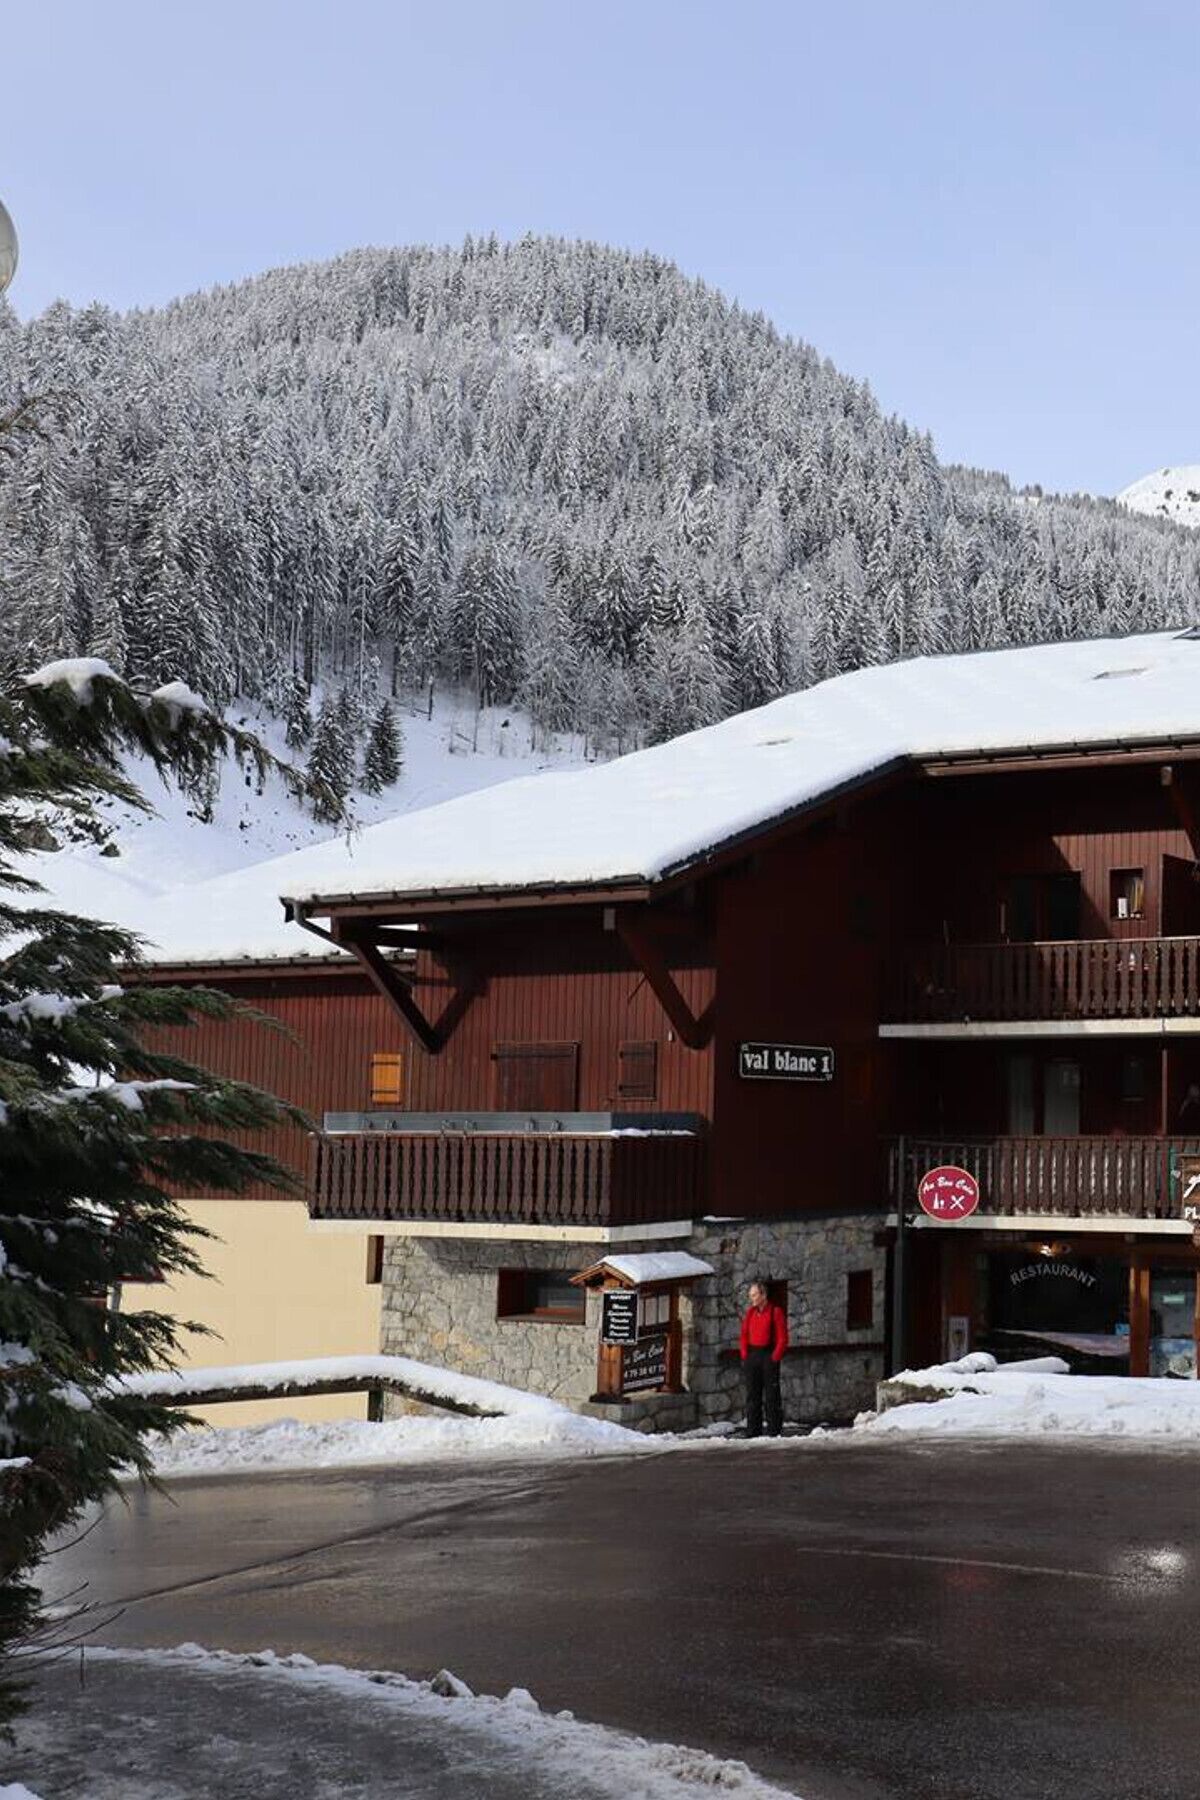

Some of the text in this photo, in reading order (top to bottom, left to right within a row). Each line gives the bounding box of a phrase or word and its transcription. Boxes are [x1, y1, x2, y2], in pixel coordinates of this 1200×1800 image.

[743, 1049, 830, 1073] val blanc 1
[1009, 1263, 1096, 1288] RESTAURANT
